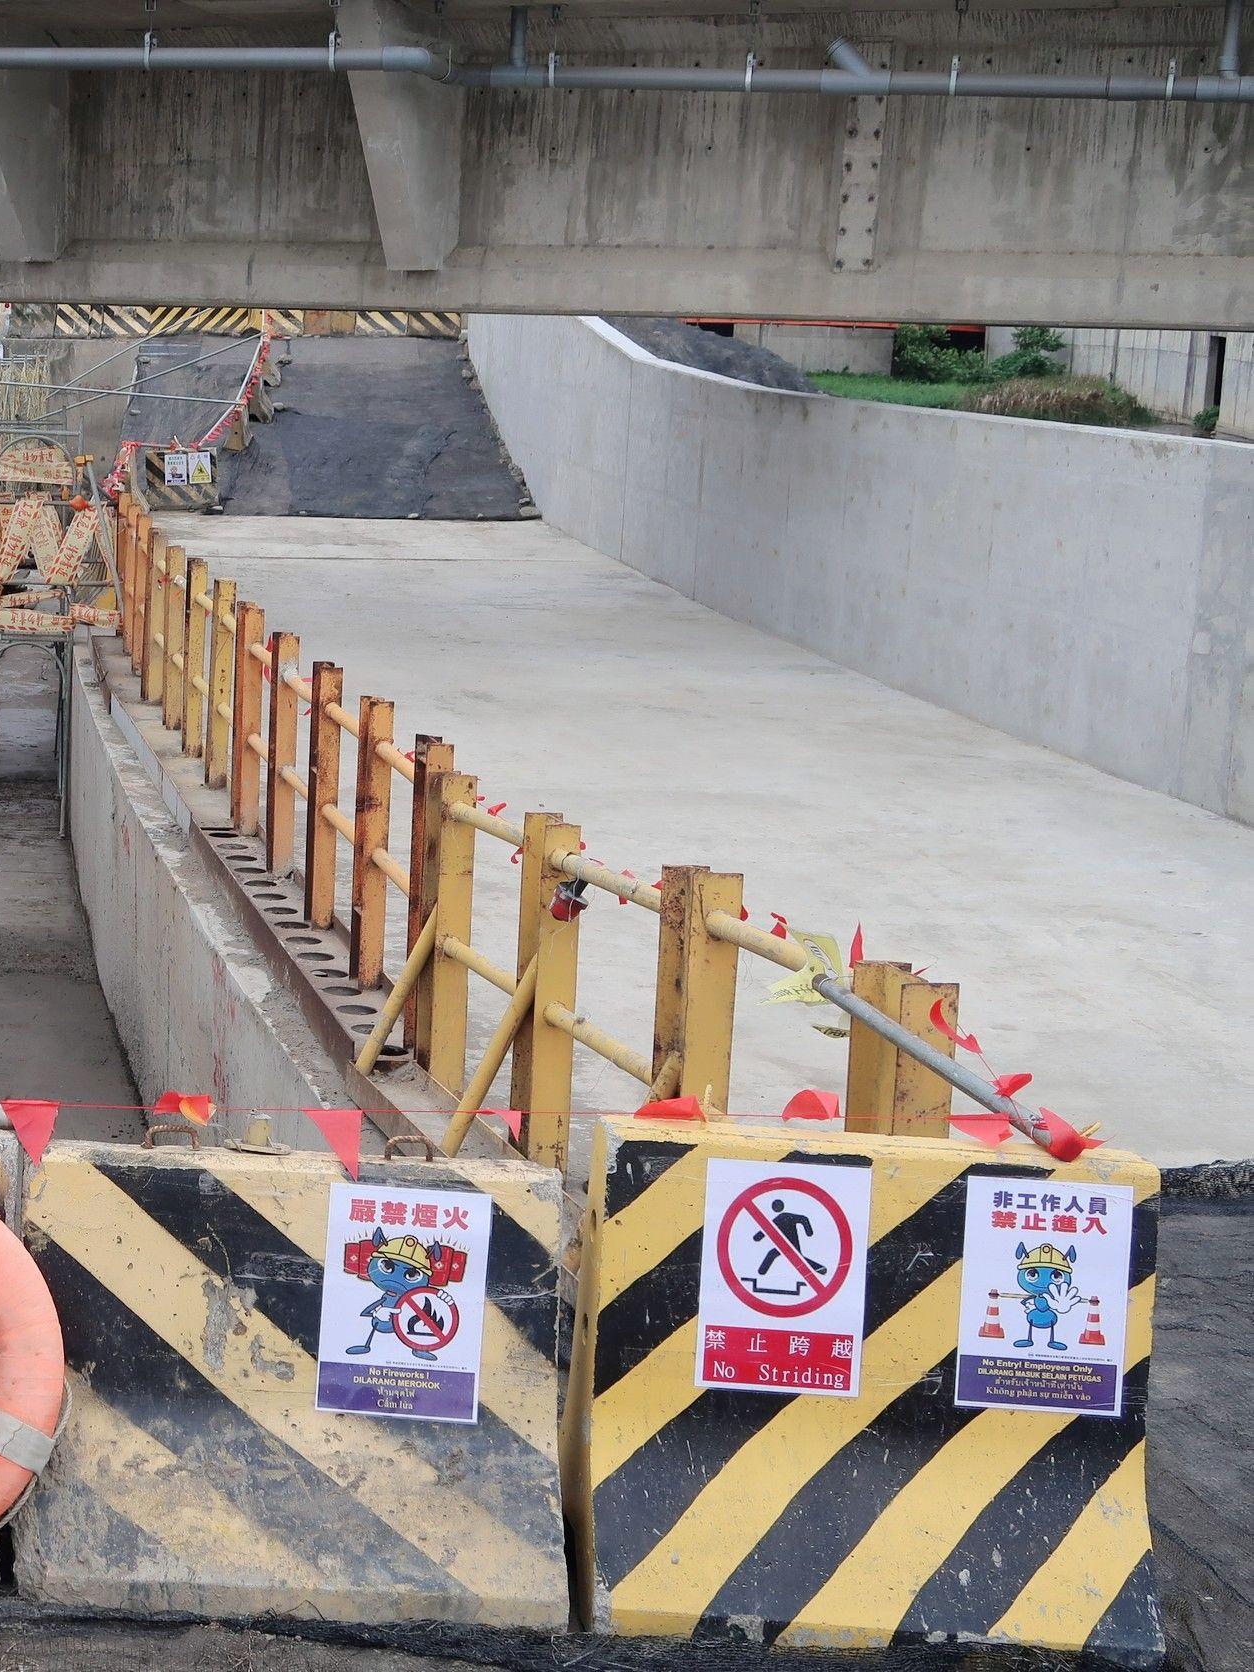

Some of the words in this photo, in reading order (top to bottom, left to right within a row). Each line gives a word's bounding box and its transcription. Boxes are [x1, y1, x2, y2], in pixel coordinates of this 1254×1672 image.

[349, 1198, 469, 1231] 嚴禁煙火
[993, 1190, 1107, 1216] 非工作人員
[991, 1210, 1107, 1235] 禁止進入
[705, 1329, 853, 1359] 禁止跨越
[369, 1367, 381, 1376] No
[382, 1368, 425, 1380] Fireworks
[713, 1361, 736, 1378] No
[759, 1364, 845, 1389] Striding
[977, 1368, 1015, 1377] DILARANG
[1015, 1371, 1041, 1379] MASUK
[1041, 1372, 1067, 1380] SELAIN
[1067, 1374, 1102, 1383] PETUGAS
[982, 1359, 995, 1367] No
[1024, 1362, 1071, 1372] Employees
[1072, 1365, 1093, 1375] Only
[353, 1376, 396, 1386] DILARANG
[397, 1380, 441, 1390] MEROKOK
